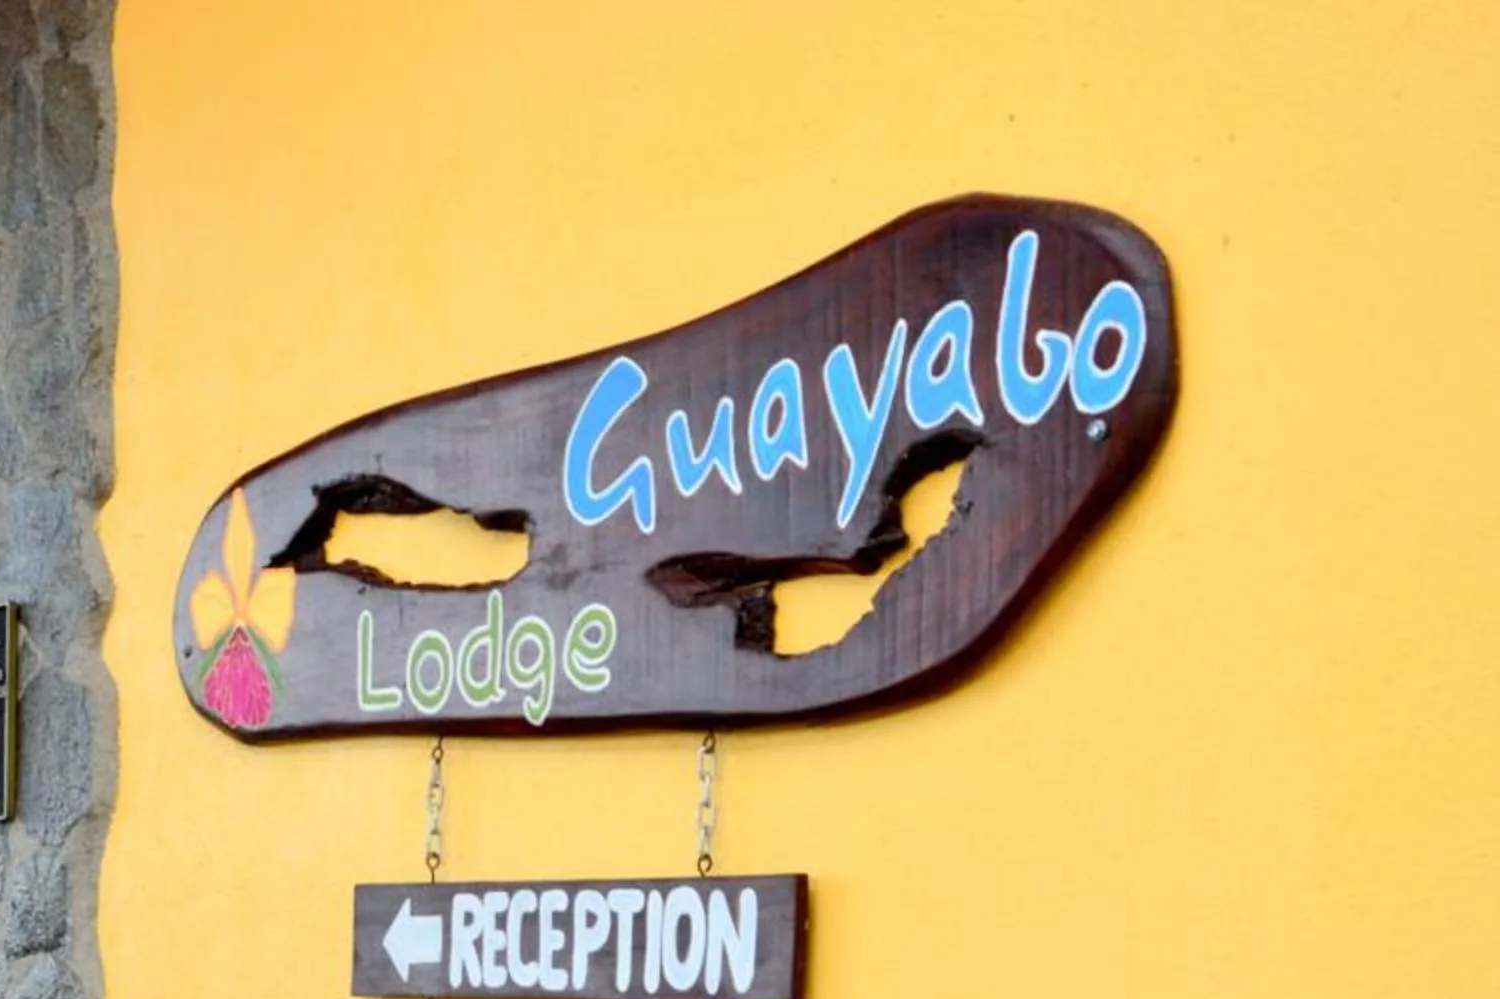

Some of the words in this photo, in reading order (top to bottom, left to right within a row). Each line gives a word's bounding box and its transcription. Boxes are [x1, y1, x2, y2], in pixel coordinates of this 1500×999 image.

[562, 229, 1148, 534] Guayabo
[353, 590, 617, 725] Lodge
[448, 885, 758, 995] RECEPTION
